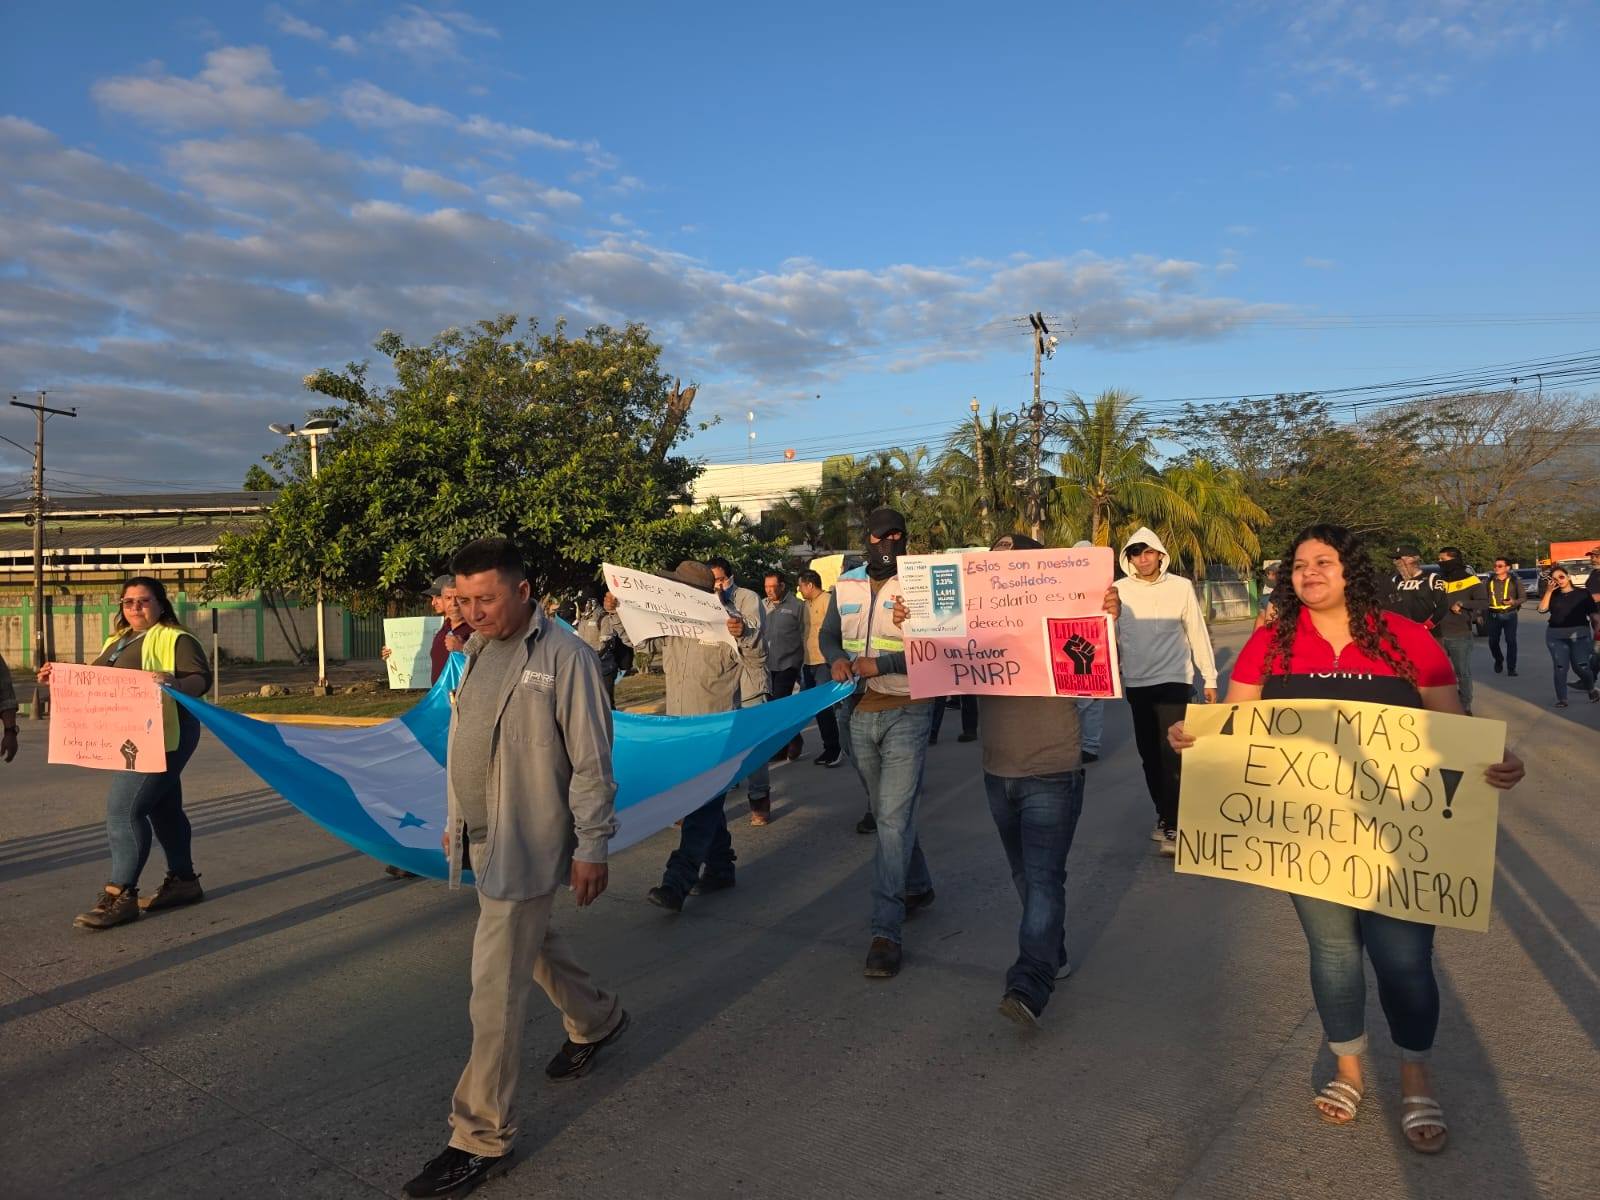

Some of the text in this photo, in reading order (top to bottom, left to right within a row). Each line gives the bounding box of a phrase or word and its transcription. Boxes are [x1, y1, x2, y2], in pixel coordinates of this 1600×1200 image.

[1008, 561, 1030, 570] son
[1397, 580, 1424, 590] FOX
[1045, 593, 1065, 601] es
[969, 615, 1024, 629] derecho
[910, 639, 1008, 665] NO un favor
[950, 661, 1020, 685] PNRP
[1056, 673, 1109, 691] DERECHOS
[1334, 708, 1420, 752] MÁS
[1220, 792, 1428, 863] QUEREMOS
[1178, 829, 1478, 917] NUESTRO DINERO
